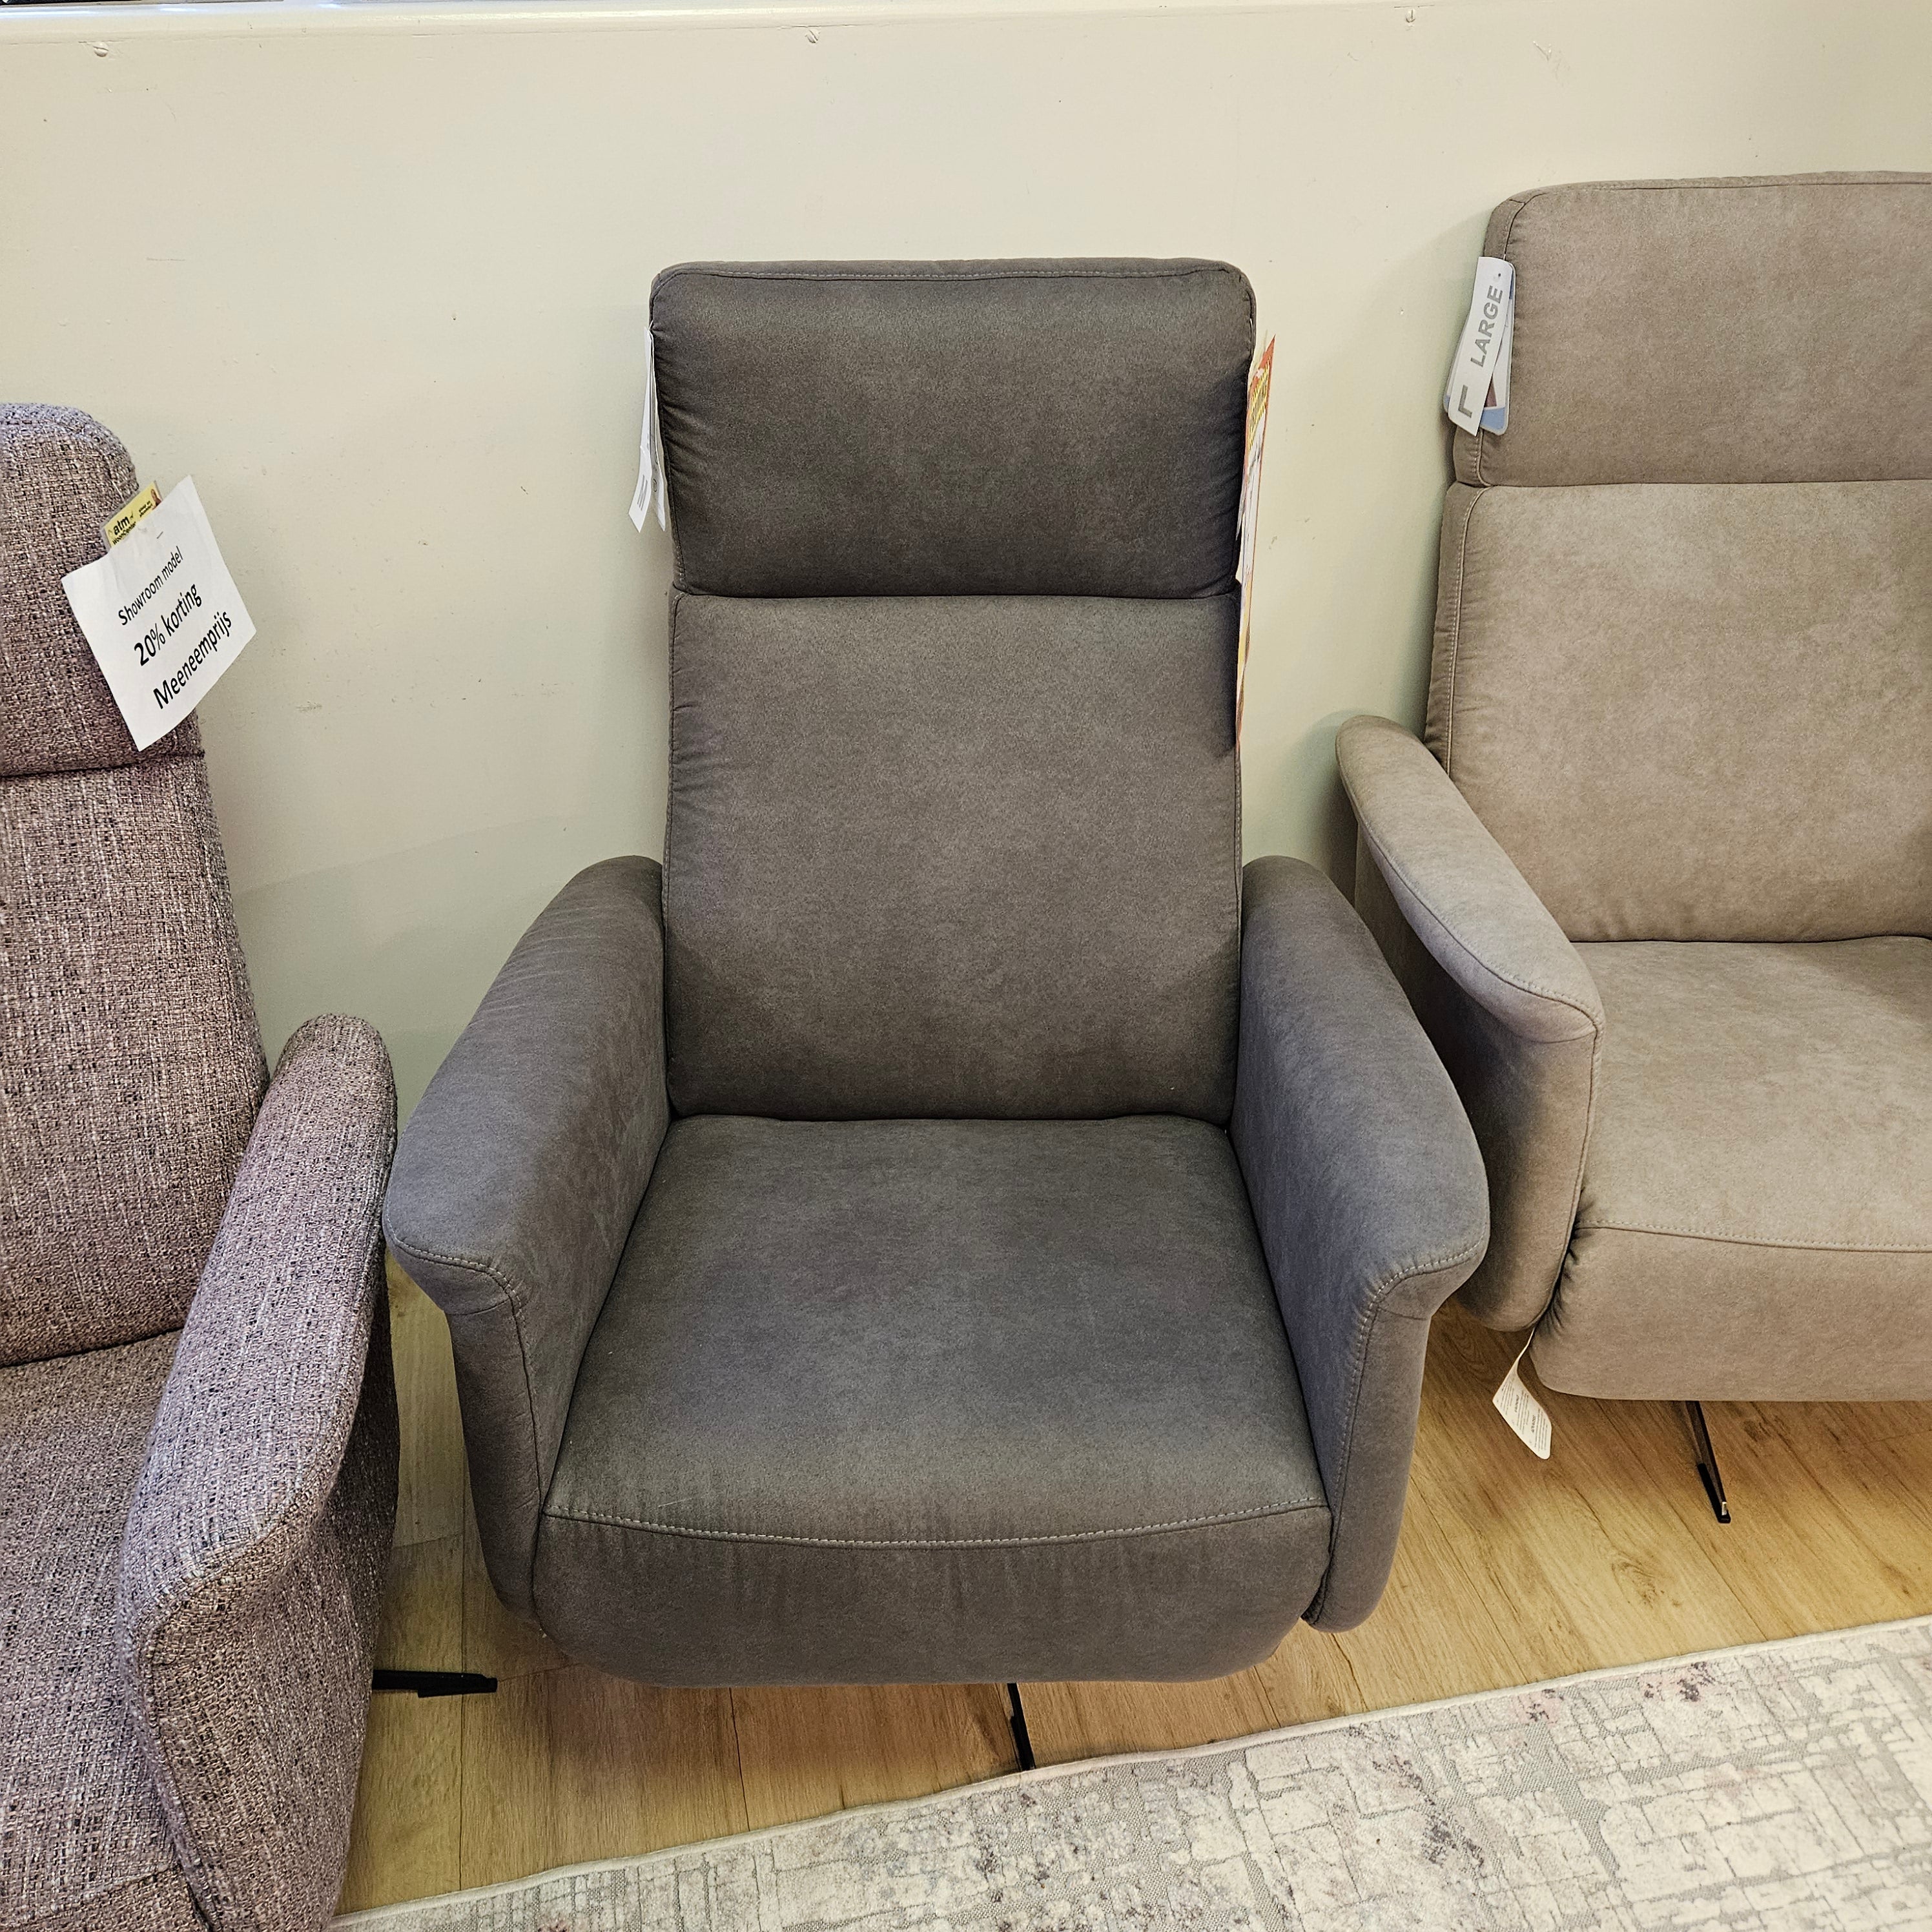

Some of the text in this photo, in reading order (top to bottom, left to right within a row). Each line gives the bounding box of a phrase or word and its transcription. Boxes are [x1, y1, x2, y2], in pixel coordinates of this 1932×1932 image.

[1470, 285, 1503, 367] LARGE
[113, 516, 130, 536] atm
[118, 545, 183, 626] Showroom model
[134, 584, 202, 666] 20% korting
[153, 611, 232, 710] Meeneemprijs
